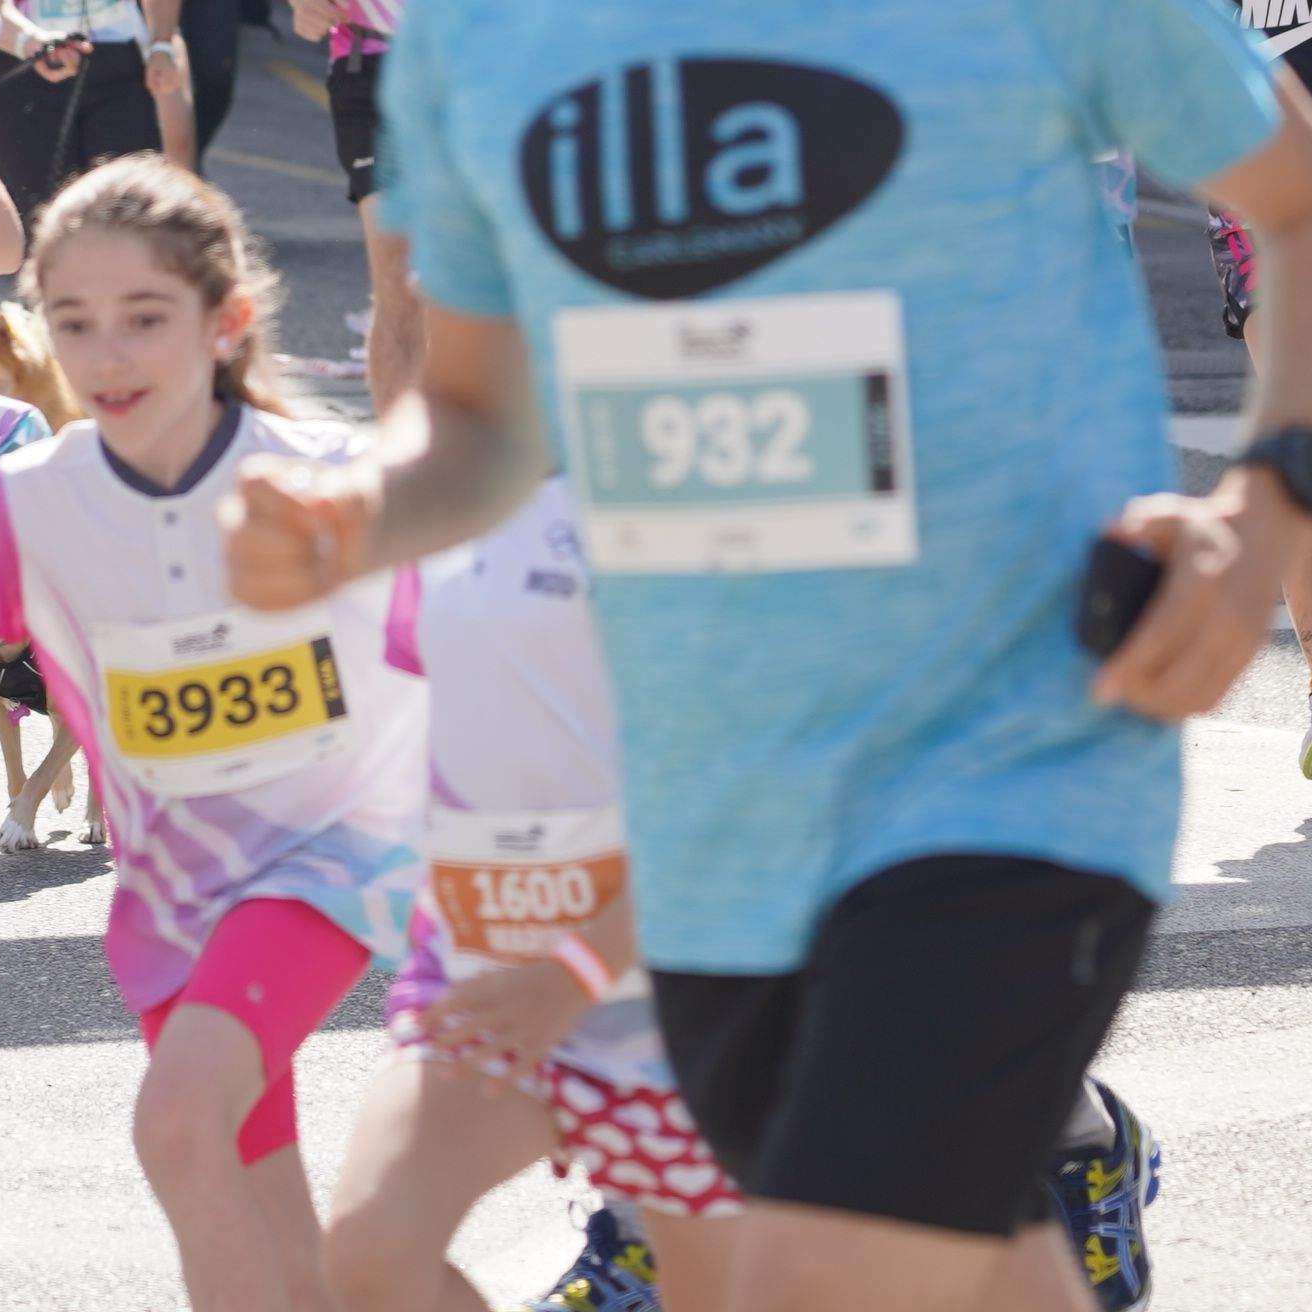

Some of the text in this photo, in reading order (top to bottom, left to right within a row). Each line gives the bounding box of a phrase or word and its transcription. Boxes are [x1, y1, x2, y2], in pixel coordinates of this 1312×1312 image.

[548, 58, 805, 242] illa
[641, 390, 816, 489] 932
[140, 664, 300, 738] 3933
[471, 868, 596, 920] 1600
